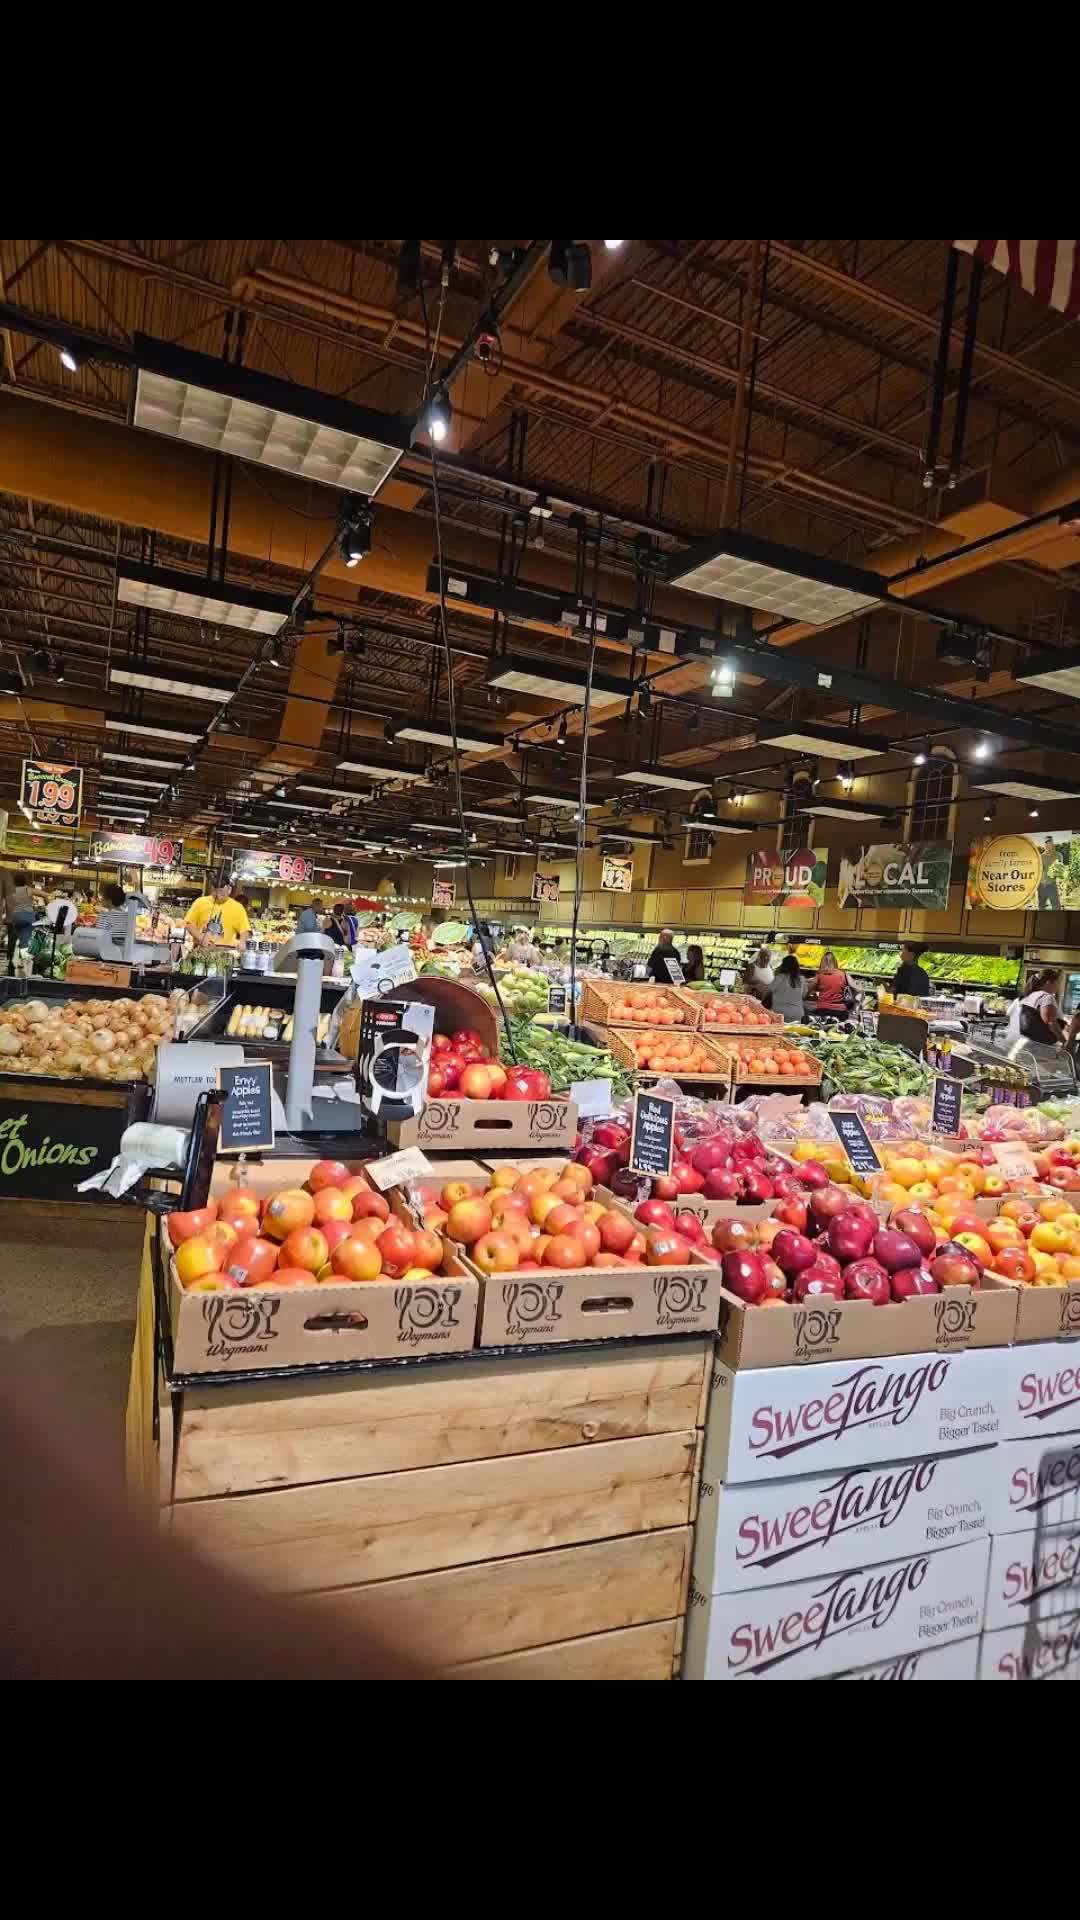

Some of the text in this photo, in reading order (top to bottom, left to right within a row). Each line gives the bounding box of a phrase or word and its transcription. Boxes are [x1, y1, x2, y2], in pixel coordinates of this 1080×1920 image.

[26, 780, 75, 810] 1.99
[754, 863, 812, 888] PROUD
[981, 869, 1035, 880] Near Our
[987, 882, 1025, 892] Stores
[174, 1076, 203, 1084] METTLER
[234, 1075, 257, 1087] Envy
[231, 1086, 261, 1099] Apples
[1, 1136, 98, 1175] Onions
[656, 1312, 699, 1329] Wegmans
[397, 1327, 451, 1347] Wegmans
[506, 1321, 554, 1340] Wegmans
[935, 1332, 970, 1348] Wegmans
[206, 1339, 268, 1362] Wegmans
[794, 1343, 833, 1360] Wegmans
[749, 1359, 950, 1450] SweeTango
[939, 1407, 957, 1421] Big
[938, 1420, 999, 1440] Bigger Taste!
[736, 1459, 937, 1560] SweeTango
[927, 1499, 982, 1520] Big Crunch,
[926, 1526, 957, 1541] Bigger
[728, 1557, 930, 1668] SweeTango
